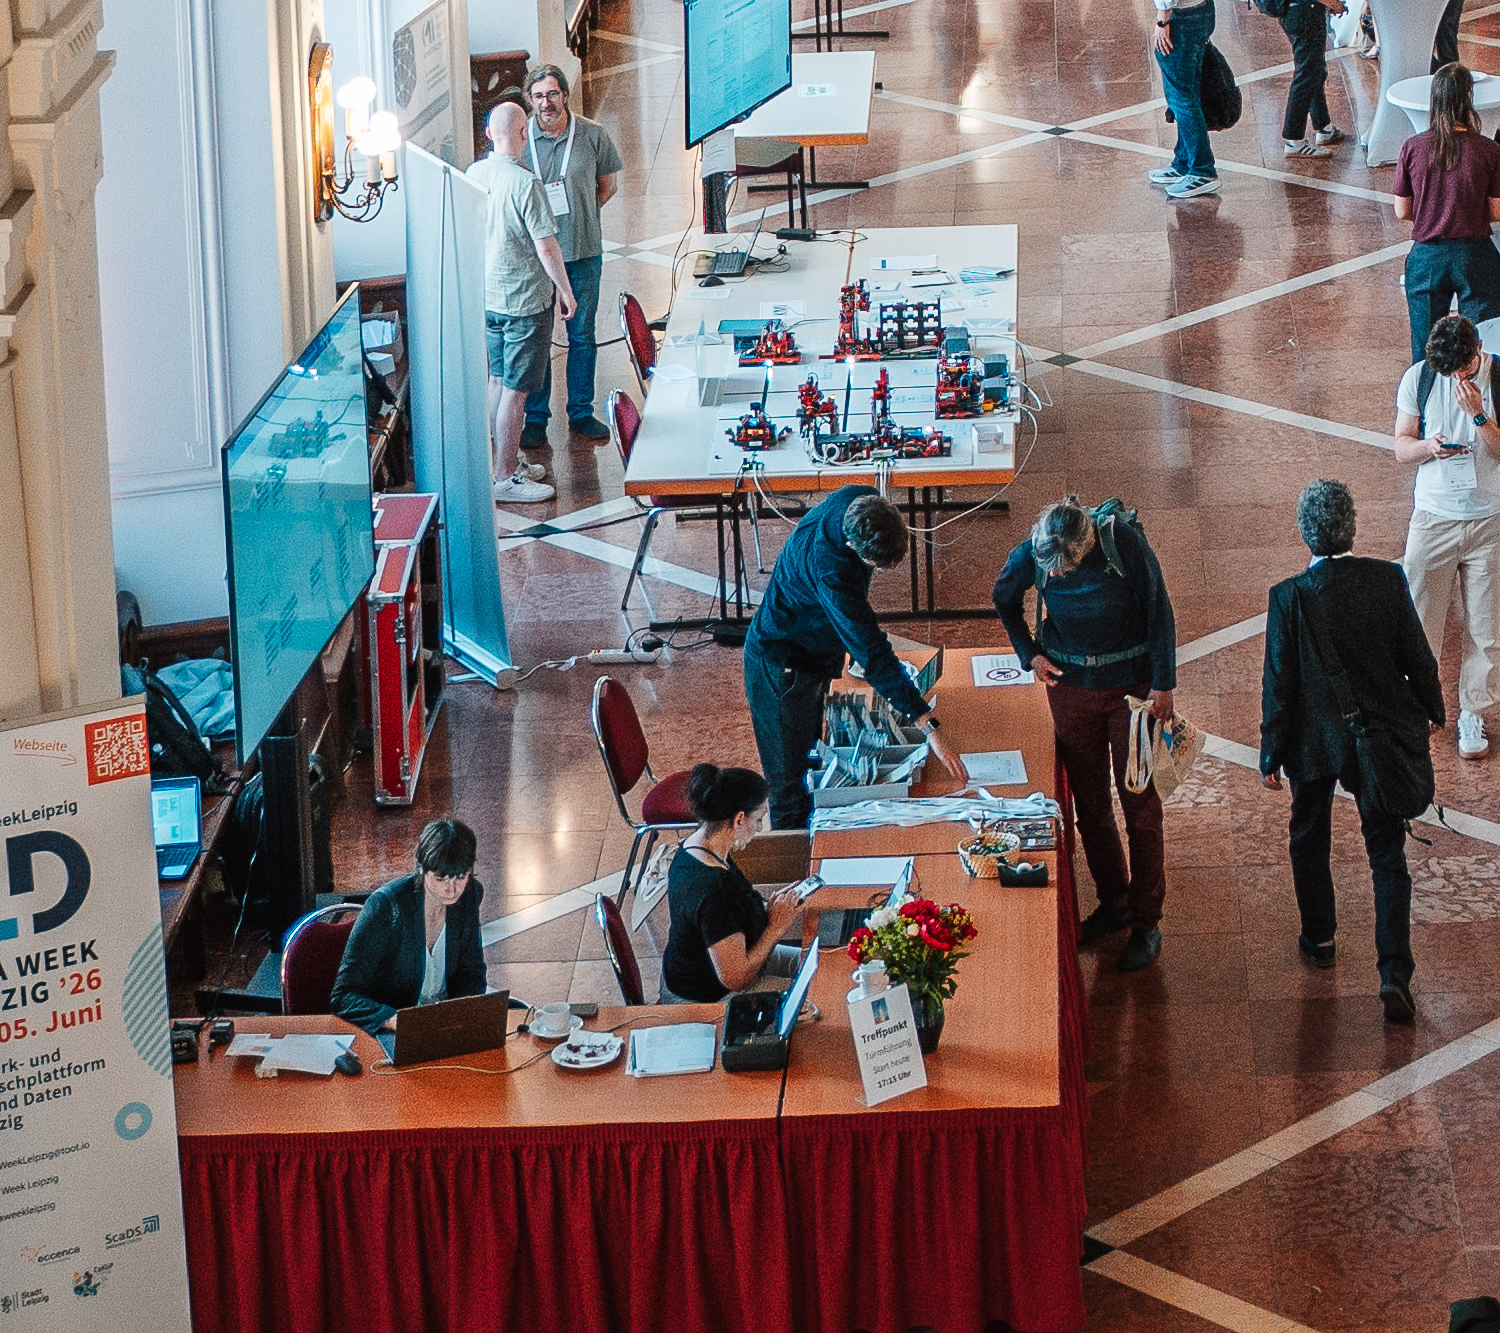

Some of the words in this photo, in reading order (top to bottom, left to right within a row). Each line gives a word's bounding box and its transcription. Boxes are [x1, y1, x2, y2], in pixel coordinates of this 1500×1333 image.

[13, 739, 68, 751] Webseite
[16, 939, 99, 977] WEEK
[46, 998, 102, 1033] Juni
[861, 1020, 908, 1044] Treffpunkt
[30, 1047, 62, 1068] und
[898, 1071, 911, 1081] Uhr
[24, 1085, 72, 1107] Daten
[0, 1183, 26, 1195] Week
[28, 1175, 59, 1190] Leipzig
[37, 1245, 81, 1263] eccenca
[22, 1288, 43, 1299] Stadt
[22, 1295, 50, 1307] Leipzig
